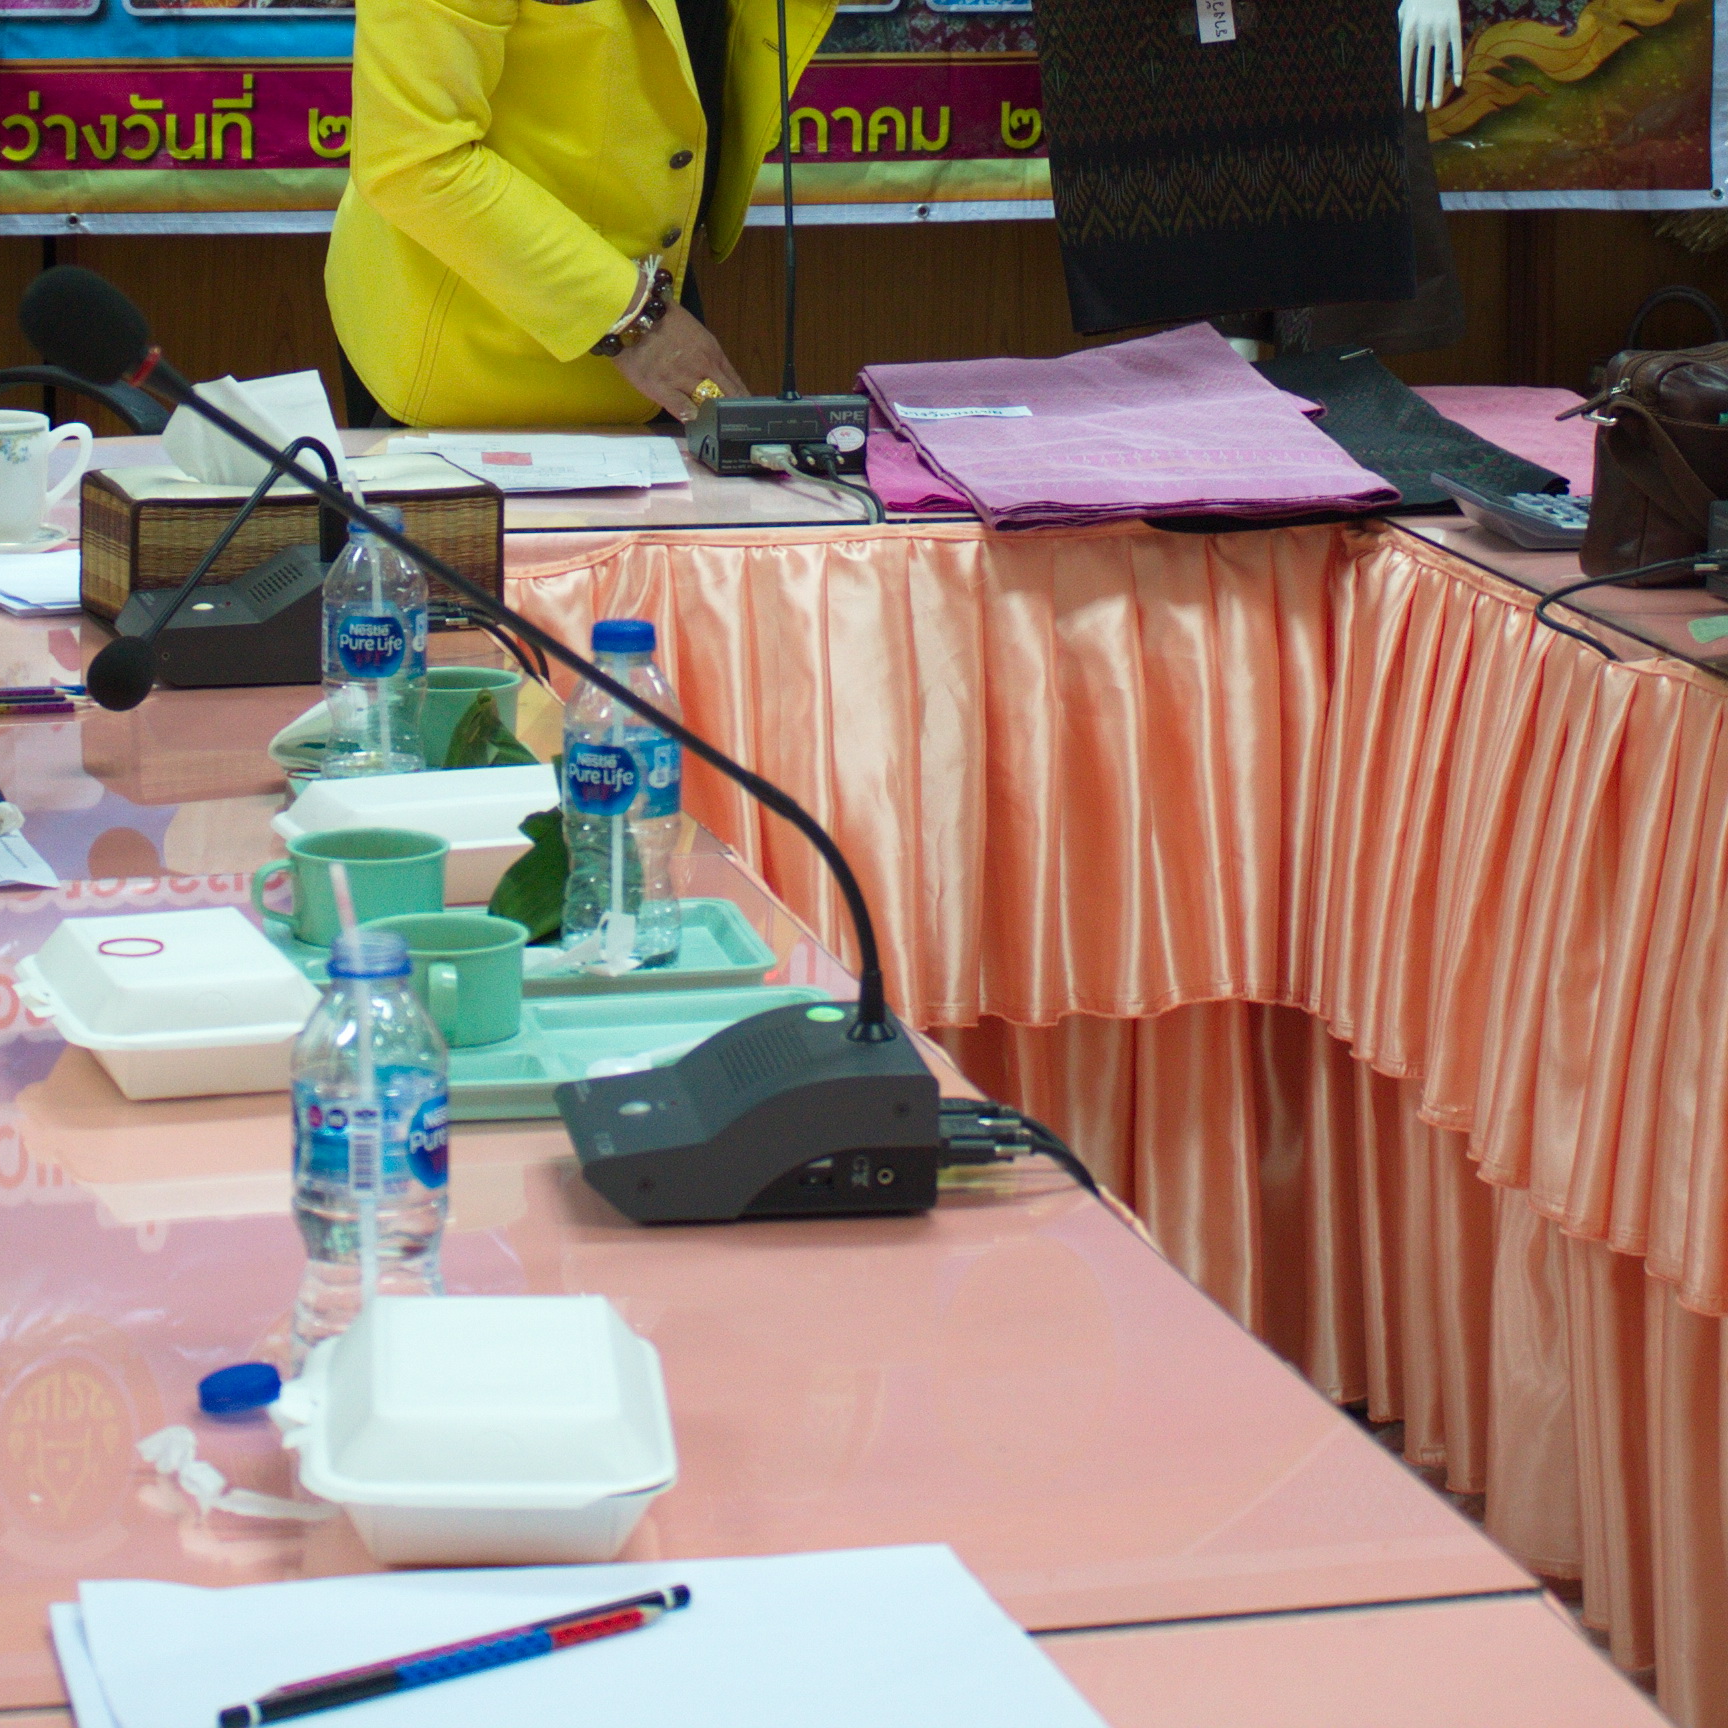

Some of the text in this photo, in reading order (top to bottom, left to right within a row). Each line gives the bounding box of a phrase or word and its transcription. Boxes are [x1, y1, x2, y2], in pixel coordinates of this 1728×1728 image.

[770, 105, 952, 155] ภาคม
[829, 410, 865, 421] NPE
[339, 633, 403, 657] Pure Life
[569, 762, 602, 785] Pure
[602, 767, 635, 793] Life
